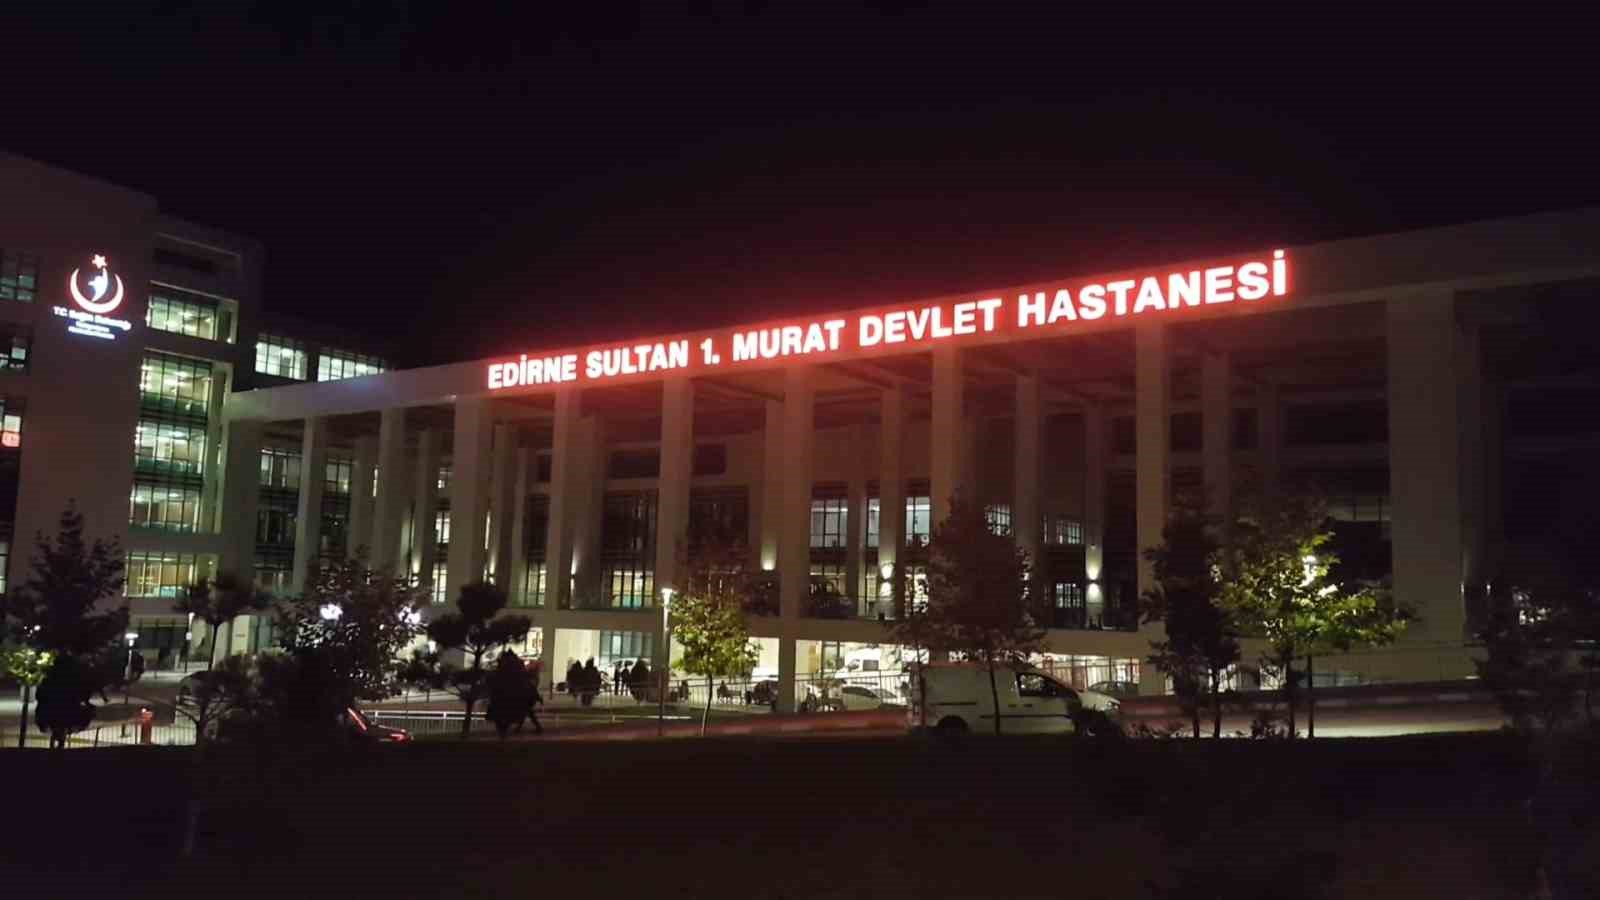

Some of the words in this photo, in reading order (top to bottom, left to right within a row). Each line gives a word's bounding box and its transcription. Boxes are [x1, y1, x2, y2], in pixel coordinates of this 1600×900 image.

[487, 354, 577, 389] EDİRNE
[585, 340, 689, 379] SULTAN
[700, 339, 720, 365] 1.
[732, 319, 846, 361] MURAT
[859, 298, 1002, 347] DEVLET
[1018, 249, 1287, 327] HASTANESİ
